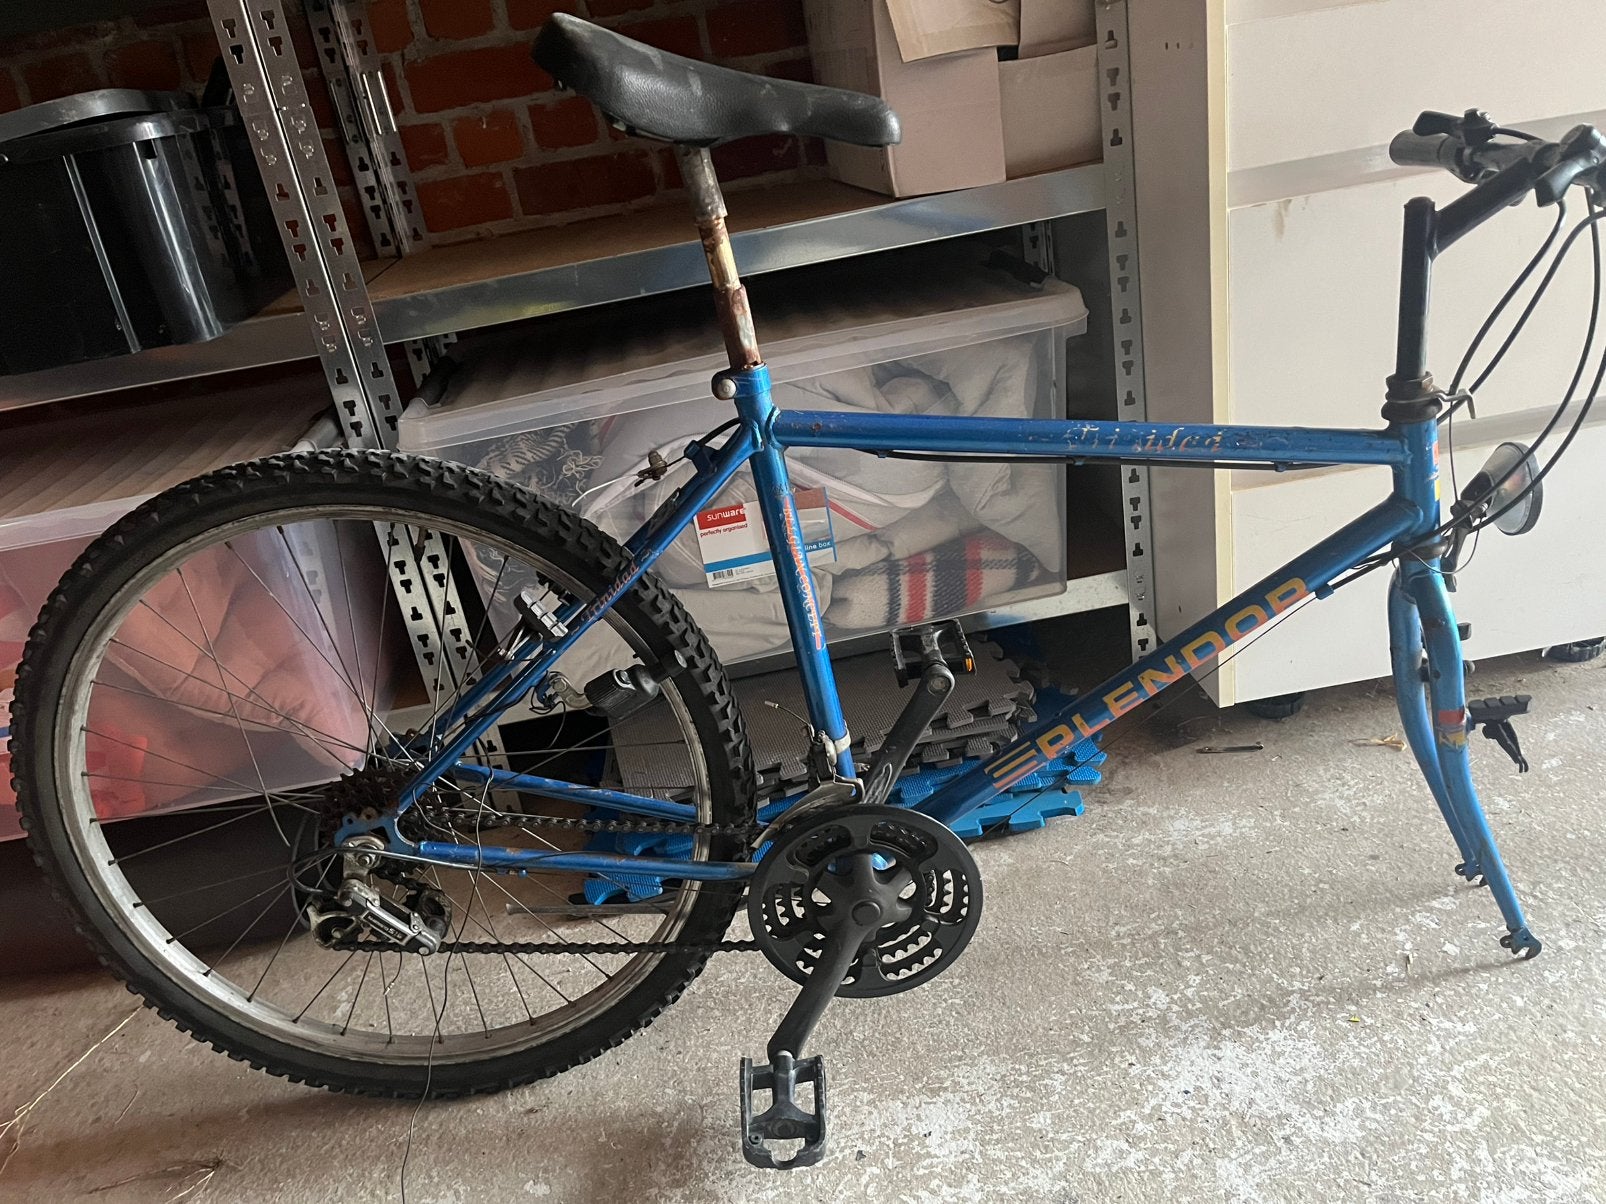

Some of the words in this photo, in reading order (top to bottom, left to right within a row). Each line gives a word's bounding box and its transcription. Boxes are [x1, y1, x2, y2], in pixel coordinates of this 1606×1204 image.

[707, 508, 745, 522] sunware
[700, 528, 722, 538] perfectly
[722, 523, 748, 533] organised
[818, 541, 831, 549] box
[581, 560, 640, 622] Trinidad
